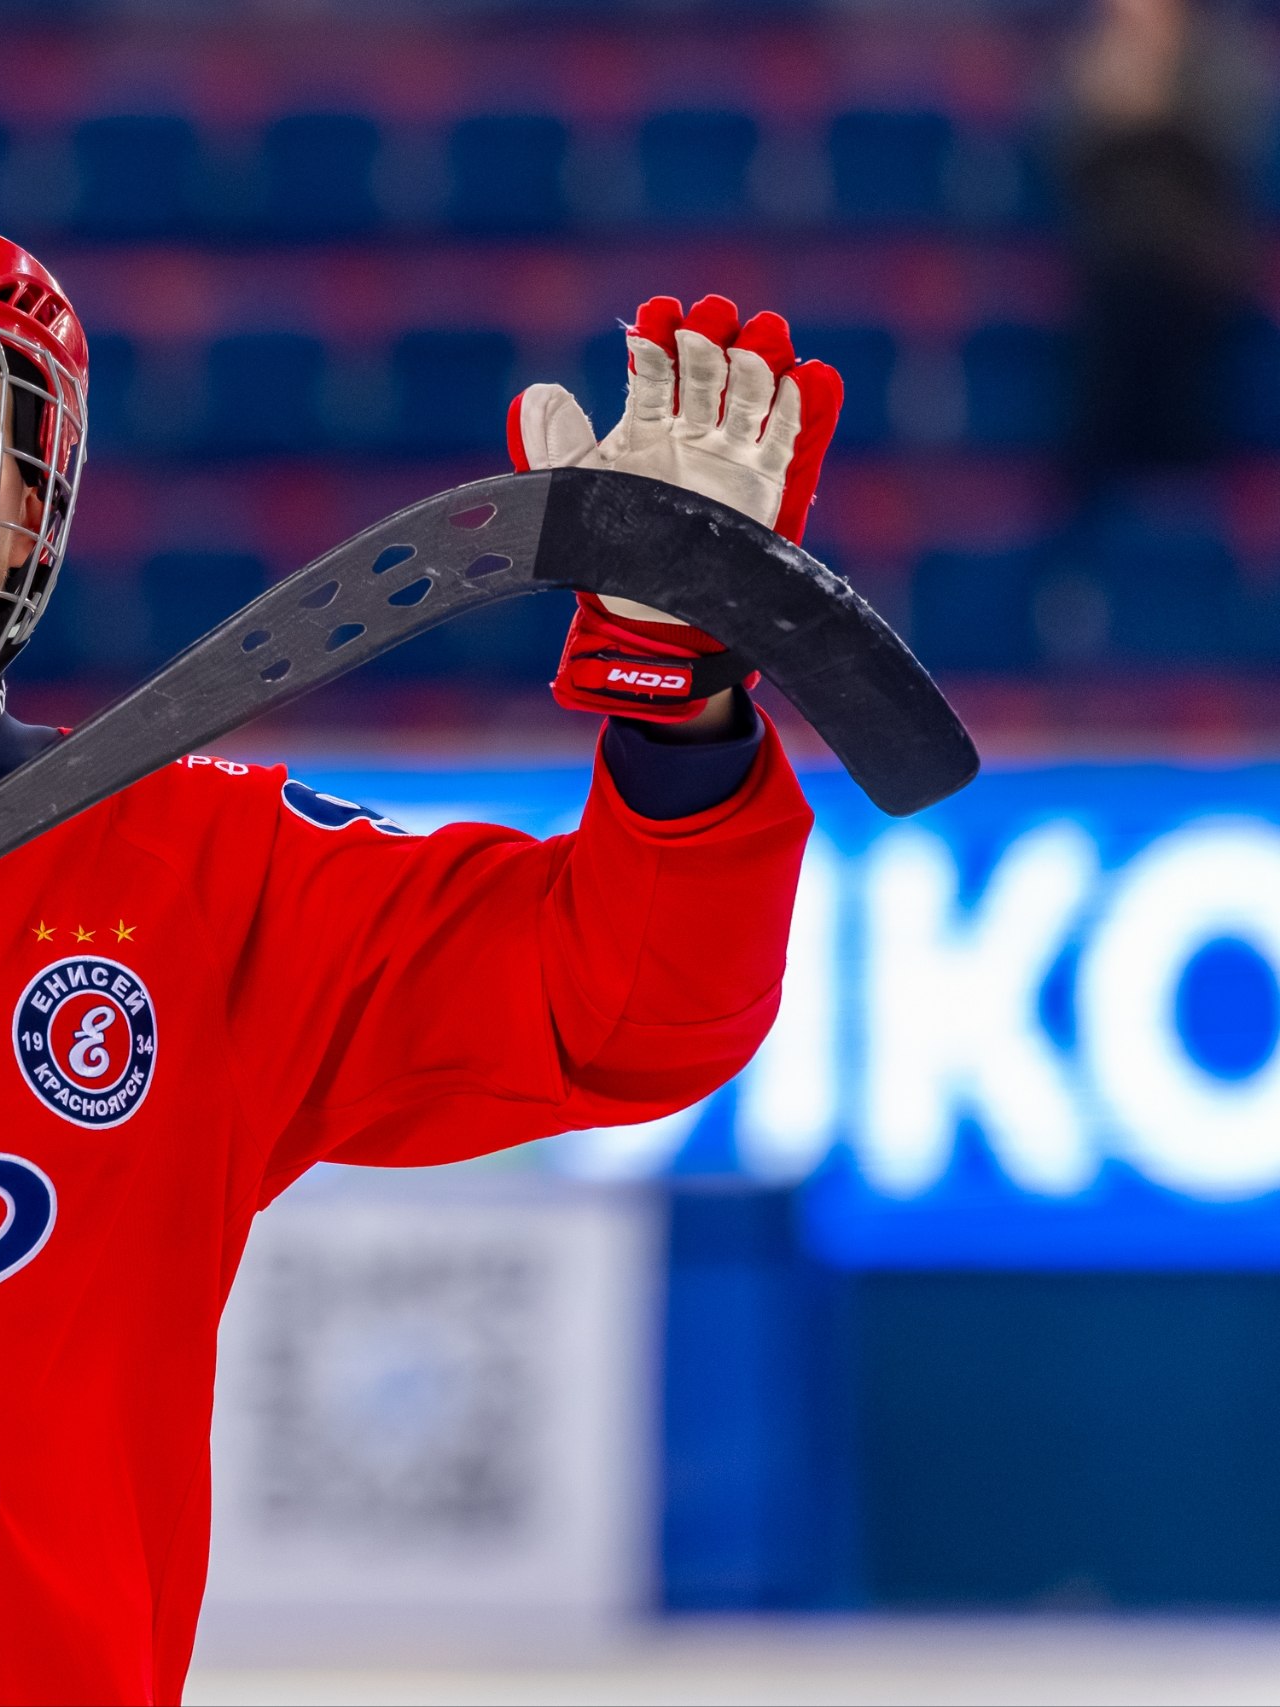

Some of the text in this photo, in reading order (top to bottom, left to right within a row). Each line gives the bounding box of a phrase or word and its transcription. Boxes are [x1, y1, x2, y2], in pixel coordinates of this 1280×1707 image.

[607, 668, 687, 689] CCM
[30, 964, 148, 1016] ЕНИСЕЙ
[21, 1031, 154, 1055] 19 34
[33, 1062, 145, 1117] КРАСНОЯРСК
